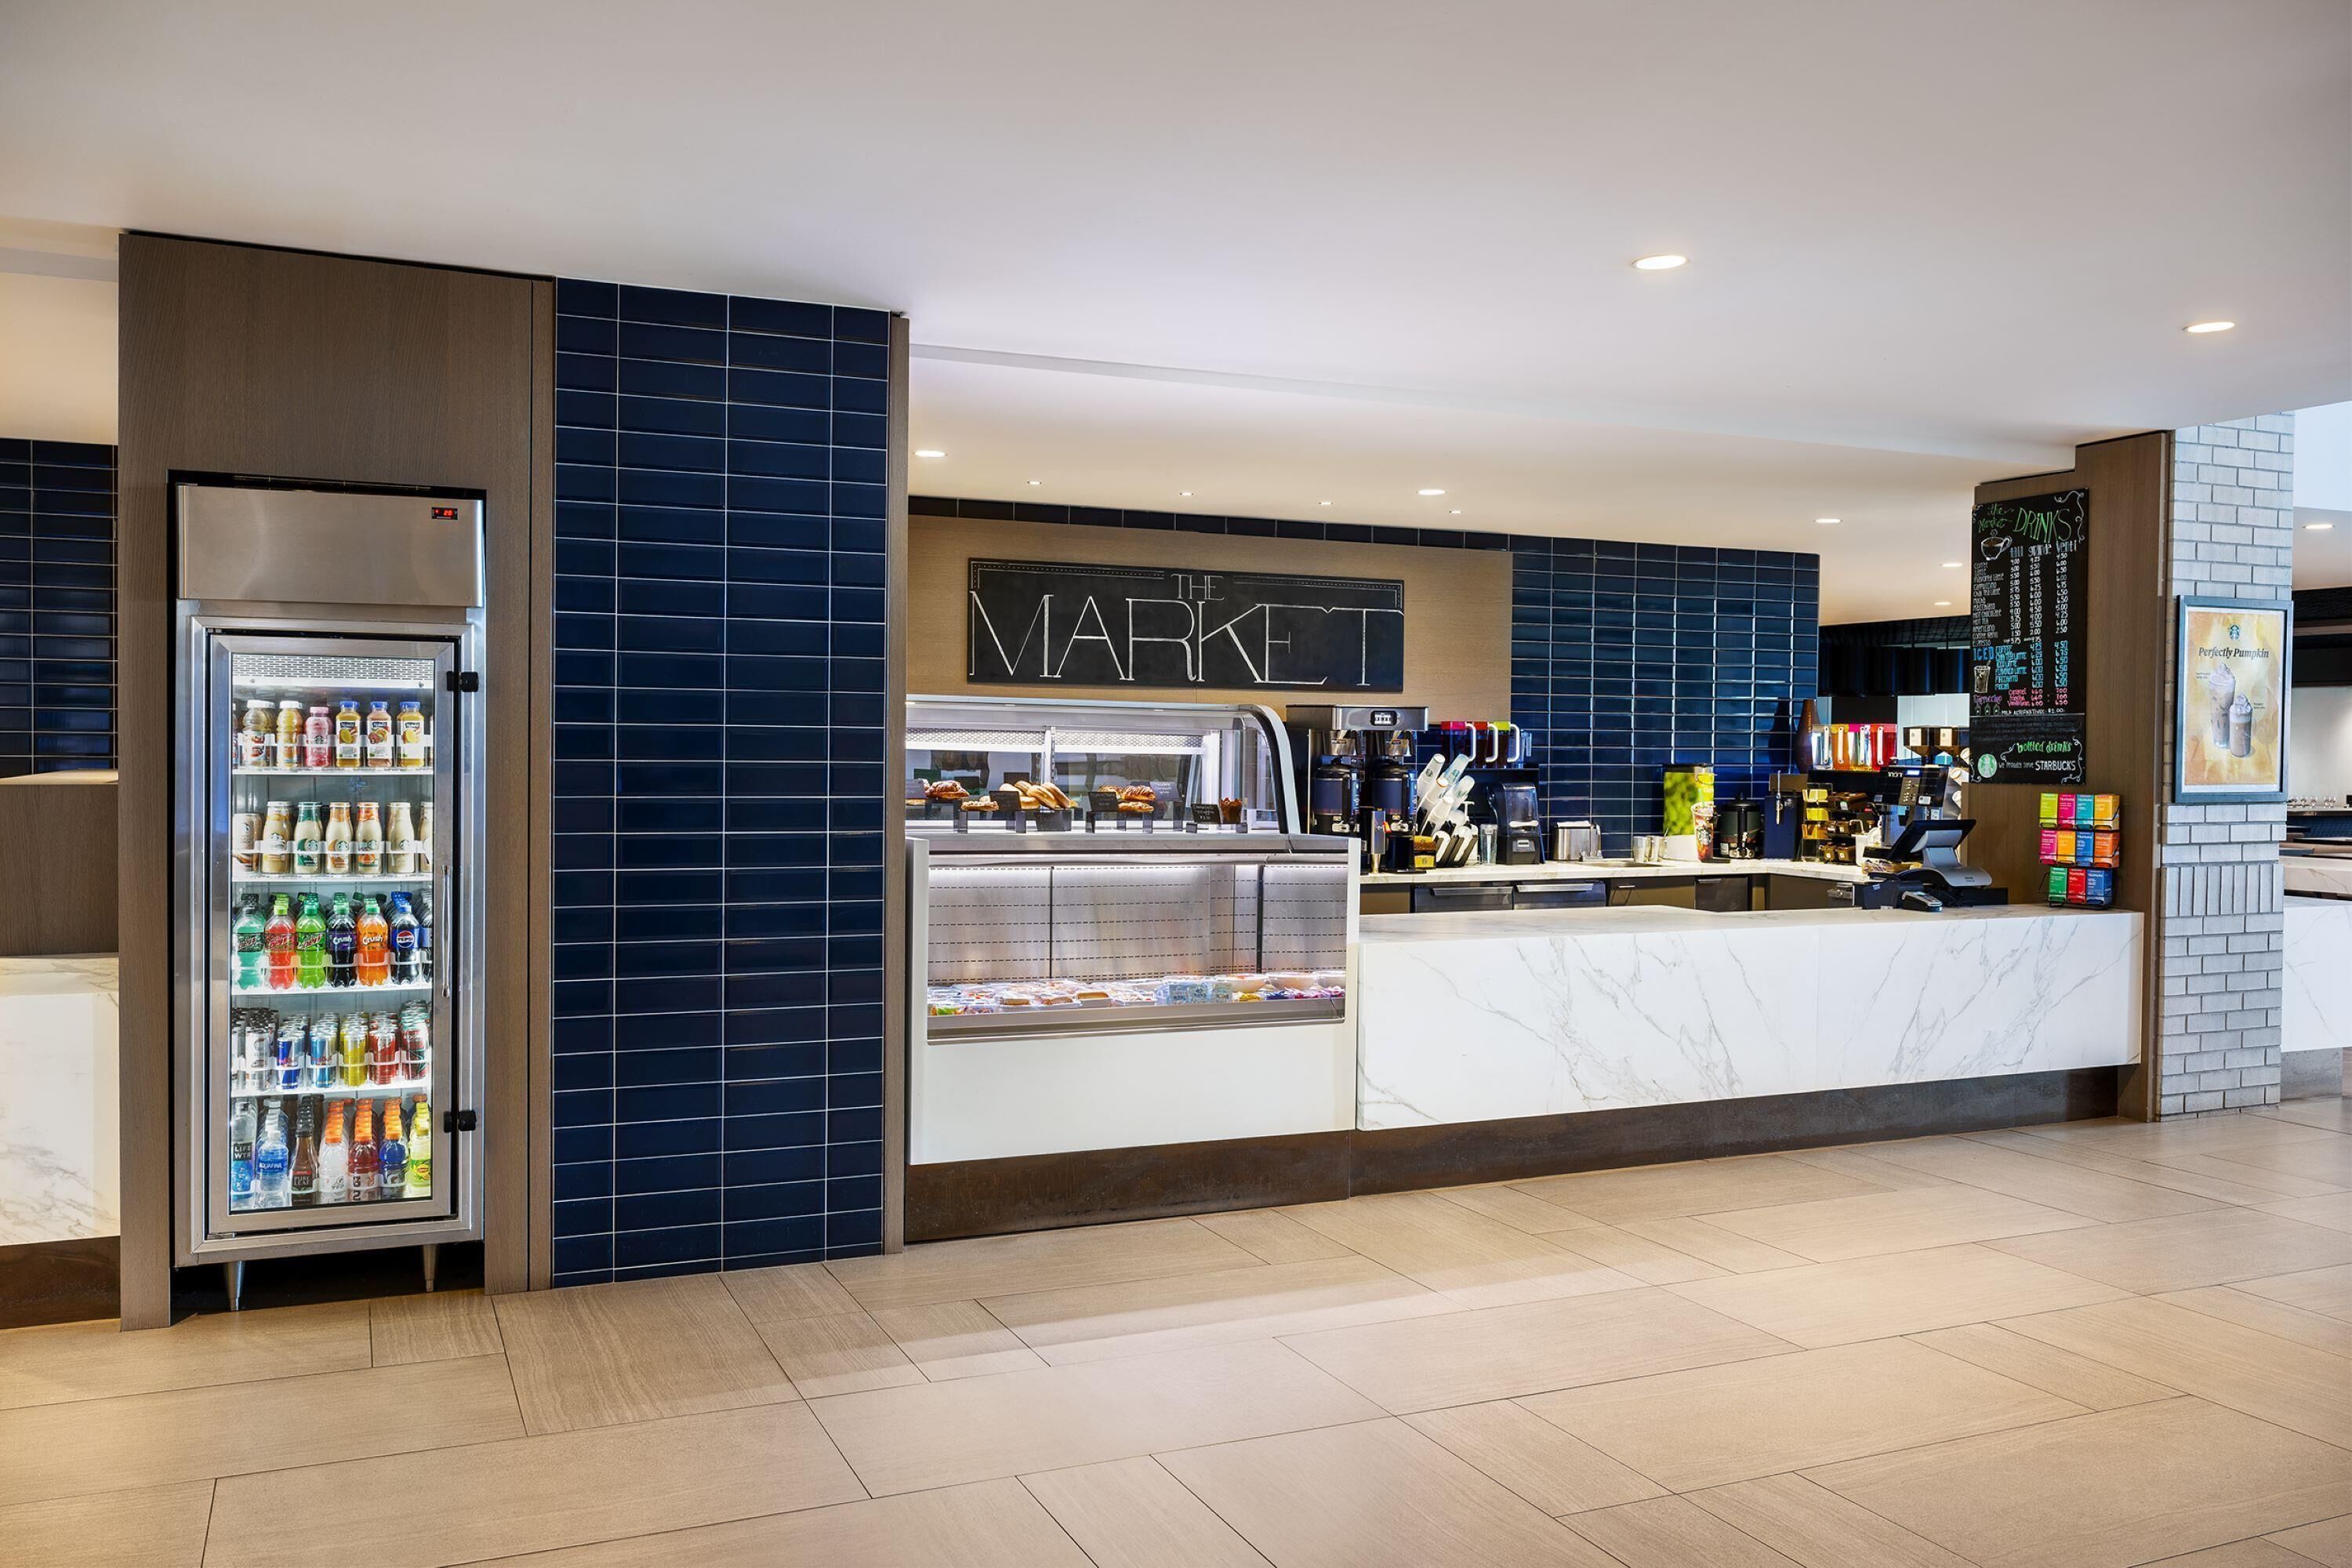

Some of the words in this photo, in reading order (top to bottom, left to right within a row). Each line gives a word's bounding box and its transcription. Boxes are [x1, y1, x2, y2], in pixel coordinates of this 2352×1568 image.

[1171, 574, 1225, 601] THE
[969, 590, 1404, 687] MARKET
[1973, 646, 1994, 661] ICED
[2198, 646, 2233, 659] Perfectly
[2233, 648, 2270, 659] Pumpkin
[2035, 760, 2076, 771] STARBUCKS
[332, 935, 353, 944] Crush
[362, 935, 383, 945] Crush
